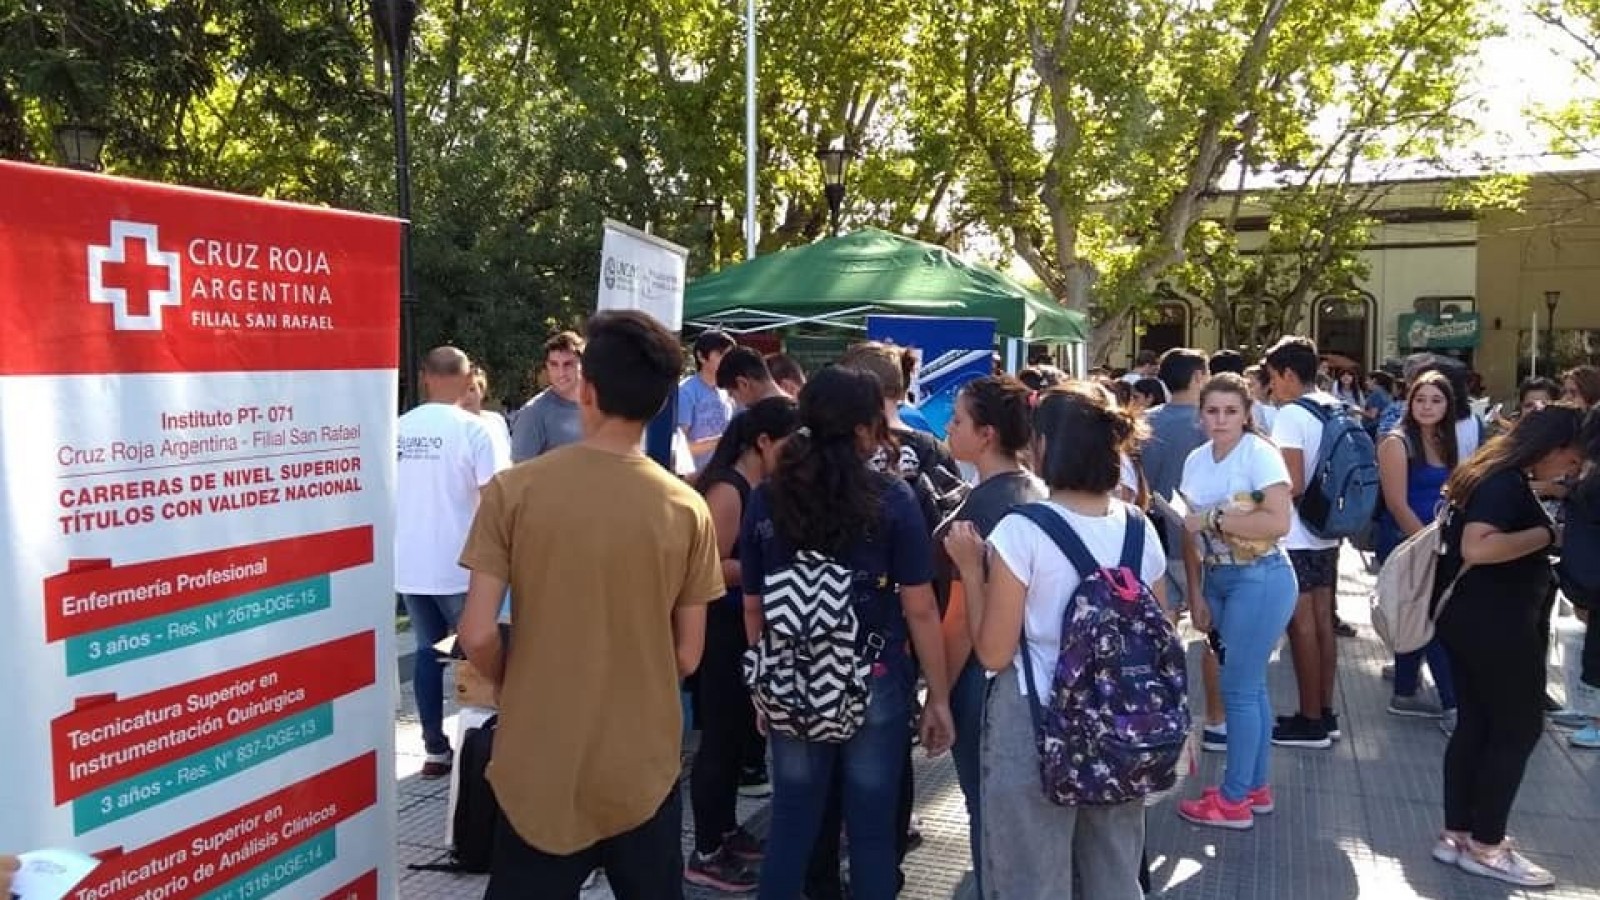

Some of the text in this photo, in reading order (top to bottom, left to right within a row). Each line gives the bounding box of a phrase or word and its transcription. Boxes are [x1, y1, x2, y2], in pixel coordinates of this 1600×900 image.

[188, 239, 331, 275] CRUZ ROJA
[191, 277, 332, 304] ARGENTINA
[191, 310, 334, 330] FILIAL SAN RAFAEL
[161, 405, 294, 431] Instituto PT- 071
[58, 445, 106, 466] Cruz
[111, 440, 154, 463] Roja
[160, 435, 238, 461] Argentina
[253, 428, 286, 448] Filial
[290, 427, 318, 443] San
[321, 424, 361, 441] Rafael
[59, 457, 361, 508] CARRERAS DE NIVEL SUPERIOR
[59, 477, 362, 535] TÍTULOS CON VALIDEZ NACIONAL
[62, 557, 268, 617] Enfermería Profesional
[89, 642, 101, 659] 3
[105, 632, 150, 656] años
[168, 621, 200, 640] Res.
[67, 671, 278, 750] Tecnicatura Superior en
[70, 688, 305, 781] Instrumentación Quirúrgica
[101, 797, 113, 814] 3
[117, 780, 161, 809] años
[177, 766, 212, 786] Res.
[75, 804, 283, 900] Tecnicatura Superior en
[193, 862, 214, 883] de
[219, 832, 279, 871] Análisis
[281, 803, 338, 839] Clínicos
